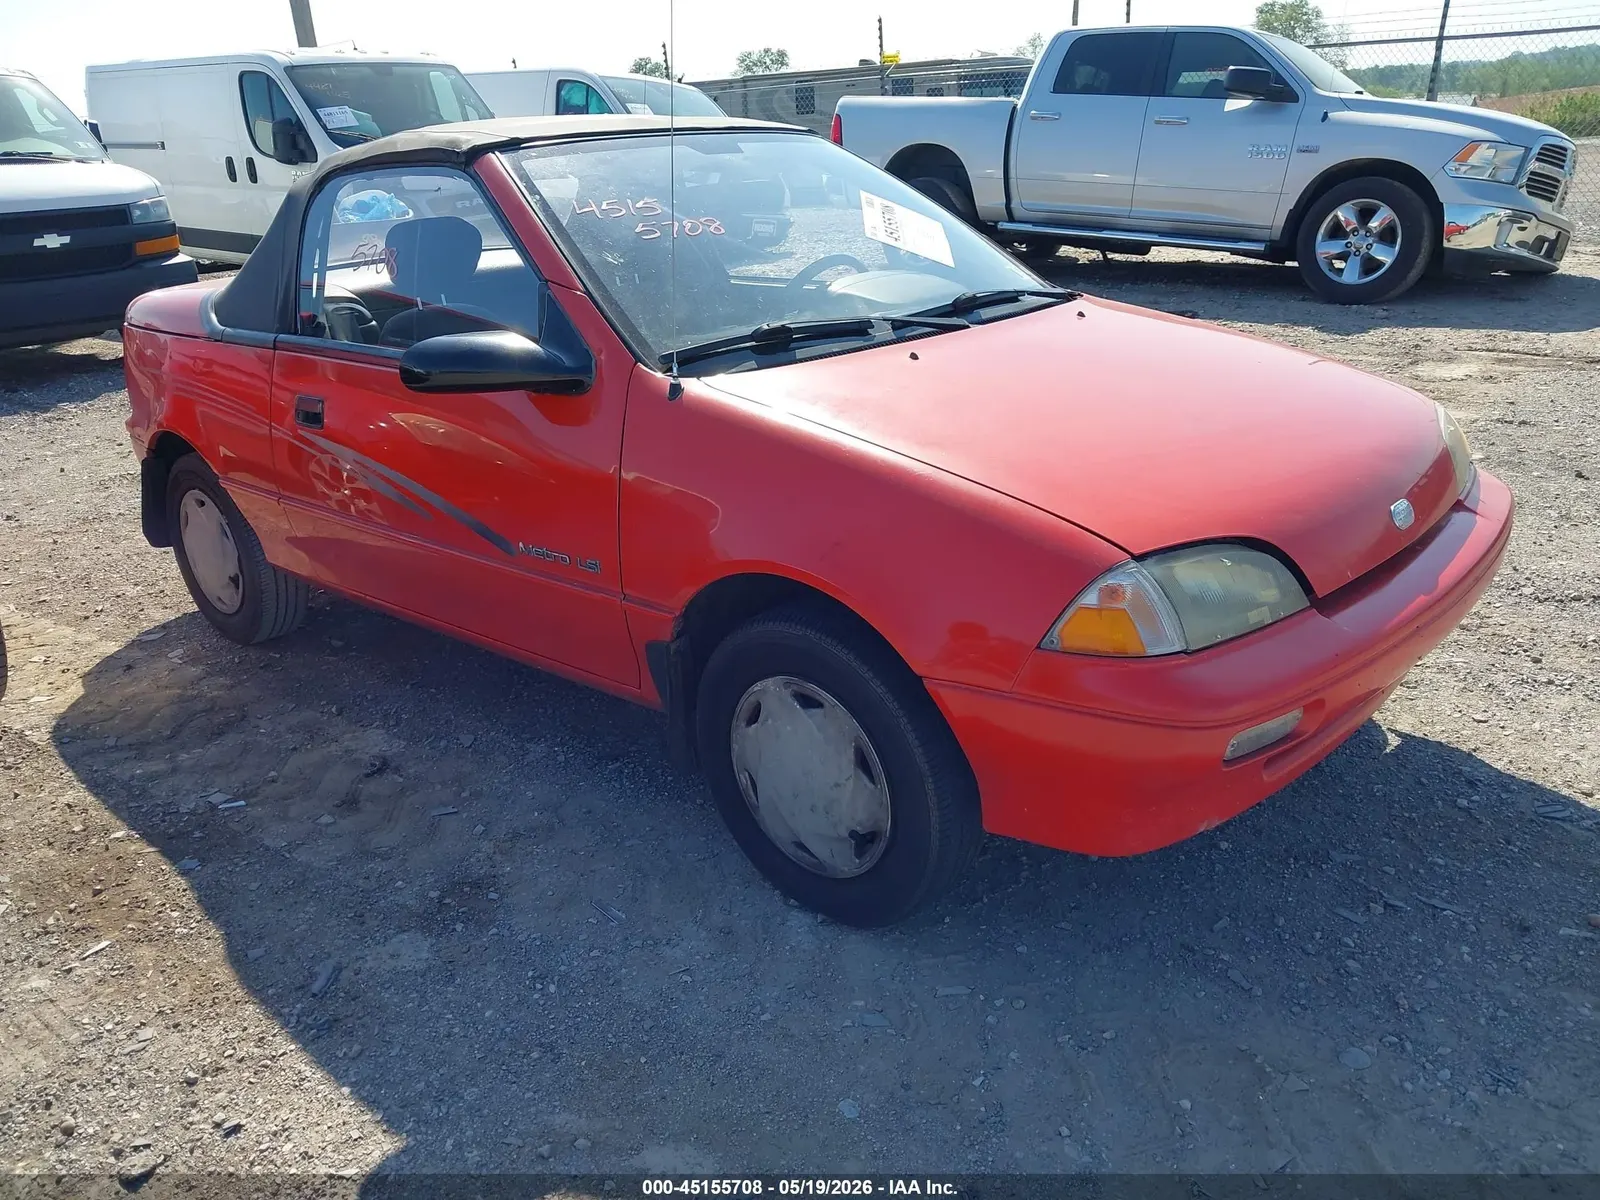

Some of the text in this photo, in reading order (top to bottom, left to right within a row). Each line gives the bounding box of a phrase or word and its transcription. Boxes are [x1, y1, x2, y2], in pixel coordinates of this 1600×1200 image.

[1247, 144, 1288, 152] RAM
[1247, 151, 1287, 160] 1500
[572, 196, 662, 219] 4515
[634, 217, 726, 240] 5708
[351, 242, 398, 279] 5708
[518, 541, 571, 566] Metro
